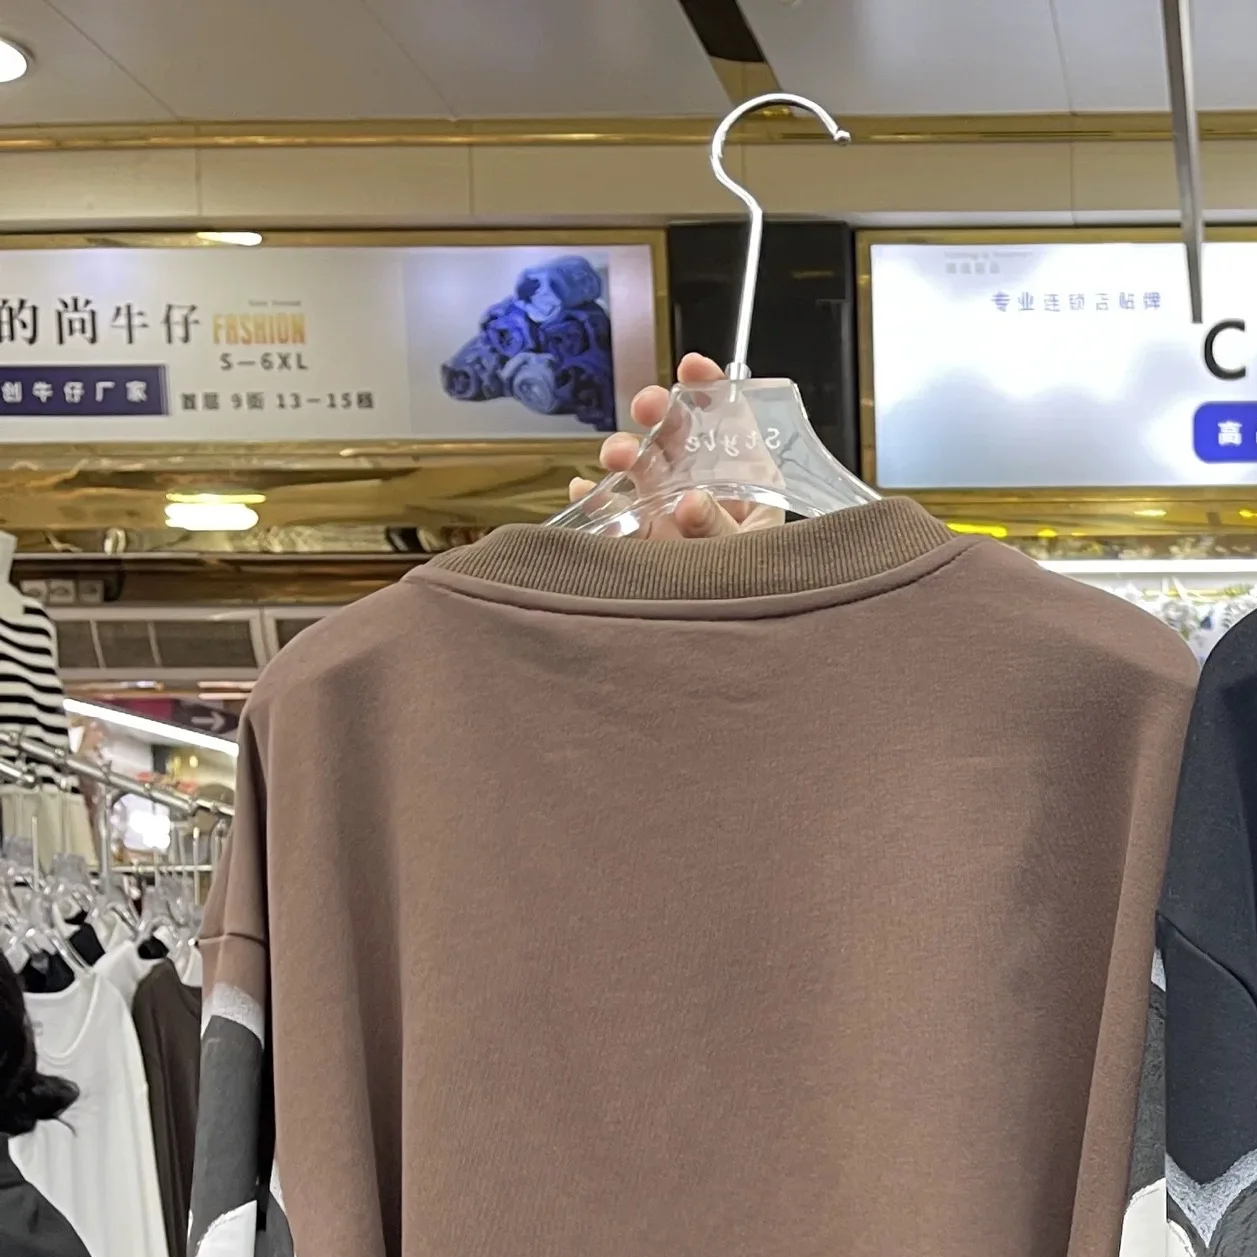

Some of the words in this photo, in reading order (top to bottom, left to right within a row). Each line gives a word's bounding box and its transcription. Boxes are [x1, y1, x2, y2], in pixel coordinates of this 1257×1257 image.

[0, 297, 200, 345] 的尚牛仔
[212, 312, 306, 345] FASHION
[1, 380, 148, 404] 创牛仔厂家
